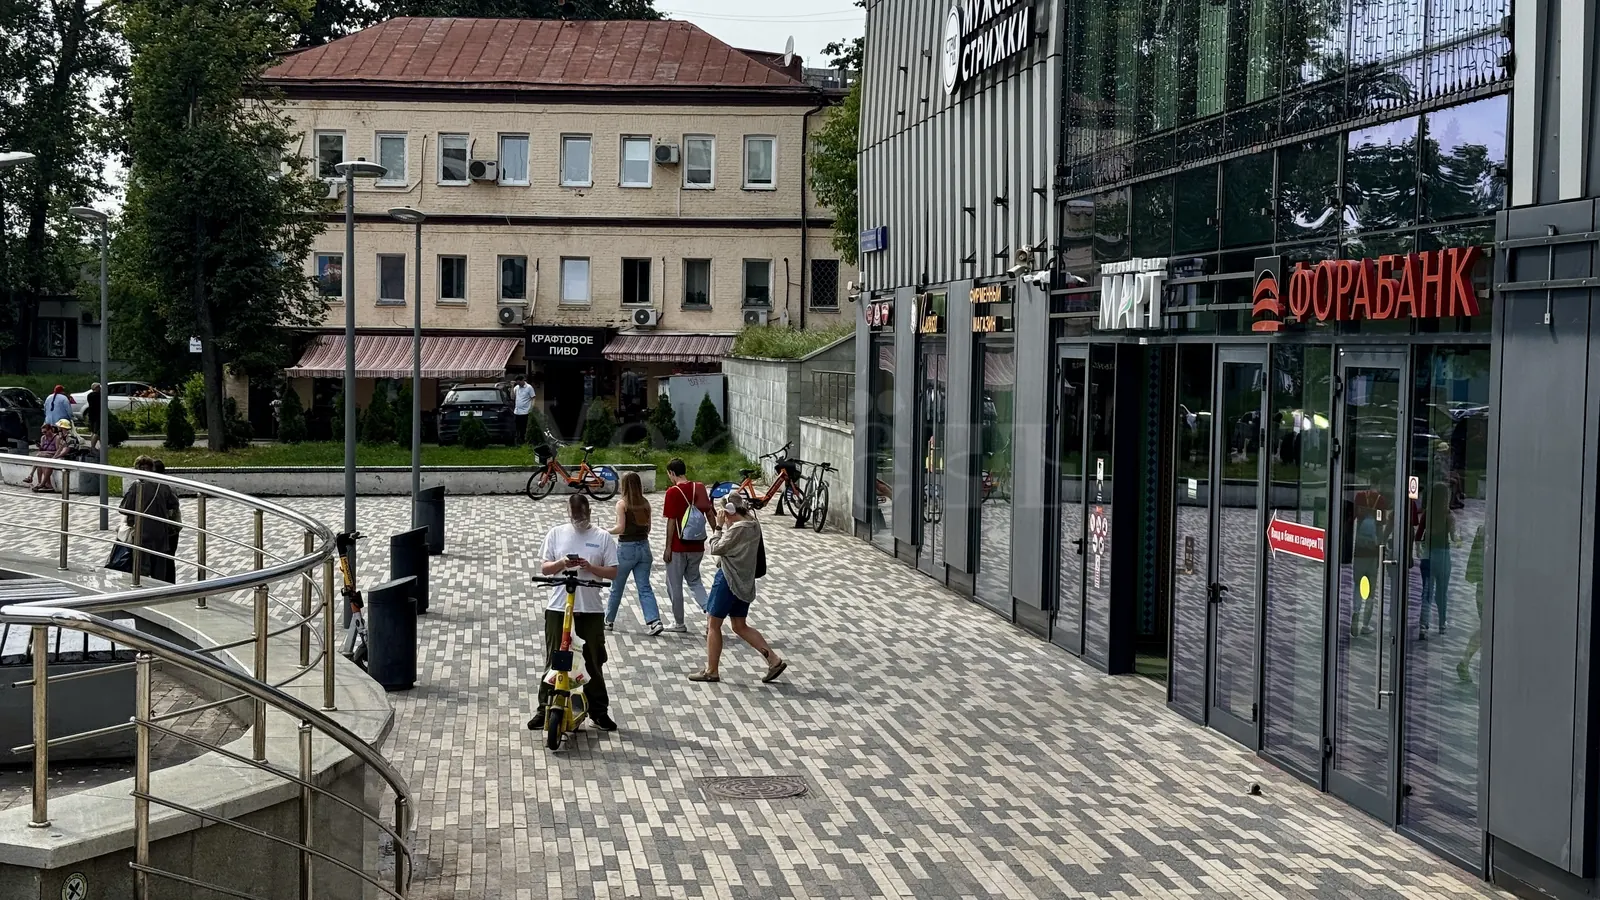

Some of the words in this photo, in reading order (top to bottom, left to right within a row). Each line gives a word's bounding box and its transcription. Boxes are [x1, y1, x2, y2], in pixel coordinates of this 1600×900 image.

[962, 0, 1016, 37] МУЖ
[962, 6, 1028, 81] СТРИЖКИ
[969, 285, 1002, 304] ФИРМЕННЫЙ
[1289, 246, 1475, 322] ФОРАБАНК
[1099, 271, 1162, 330] МАРТ
[972, 315, 997, 332] МАГАЗИН
[531, 334, 594, 345] КРАФТОВОЕ
[549, 346, 579, 356] ПИВО
